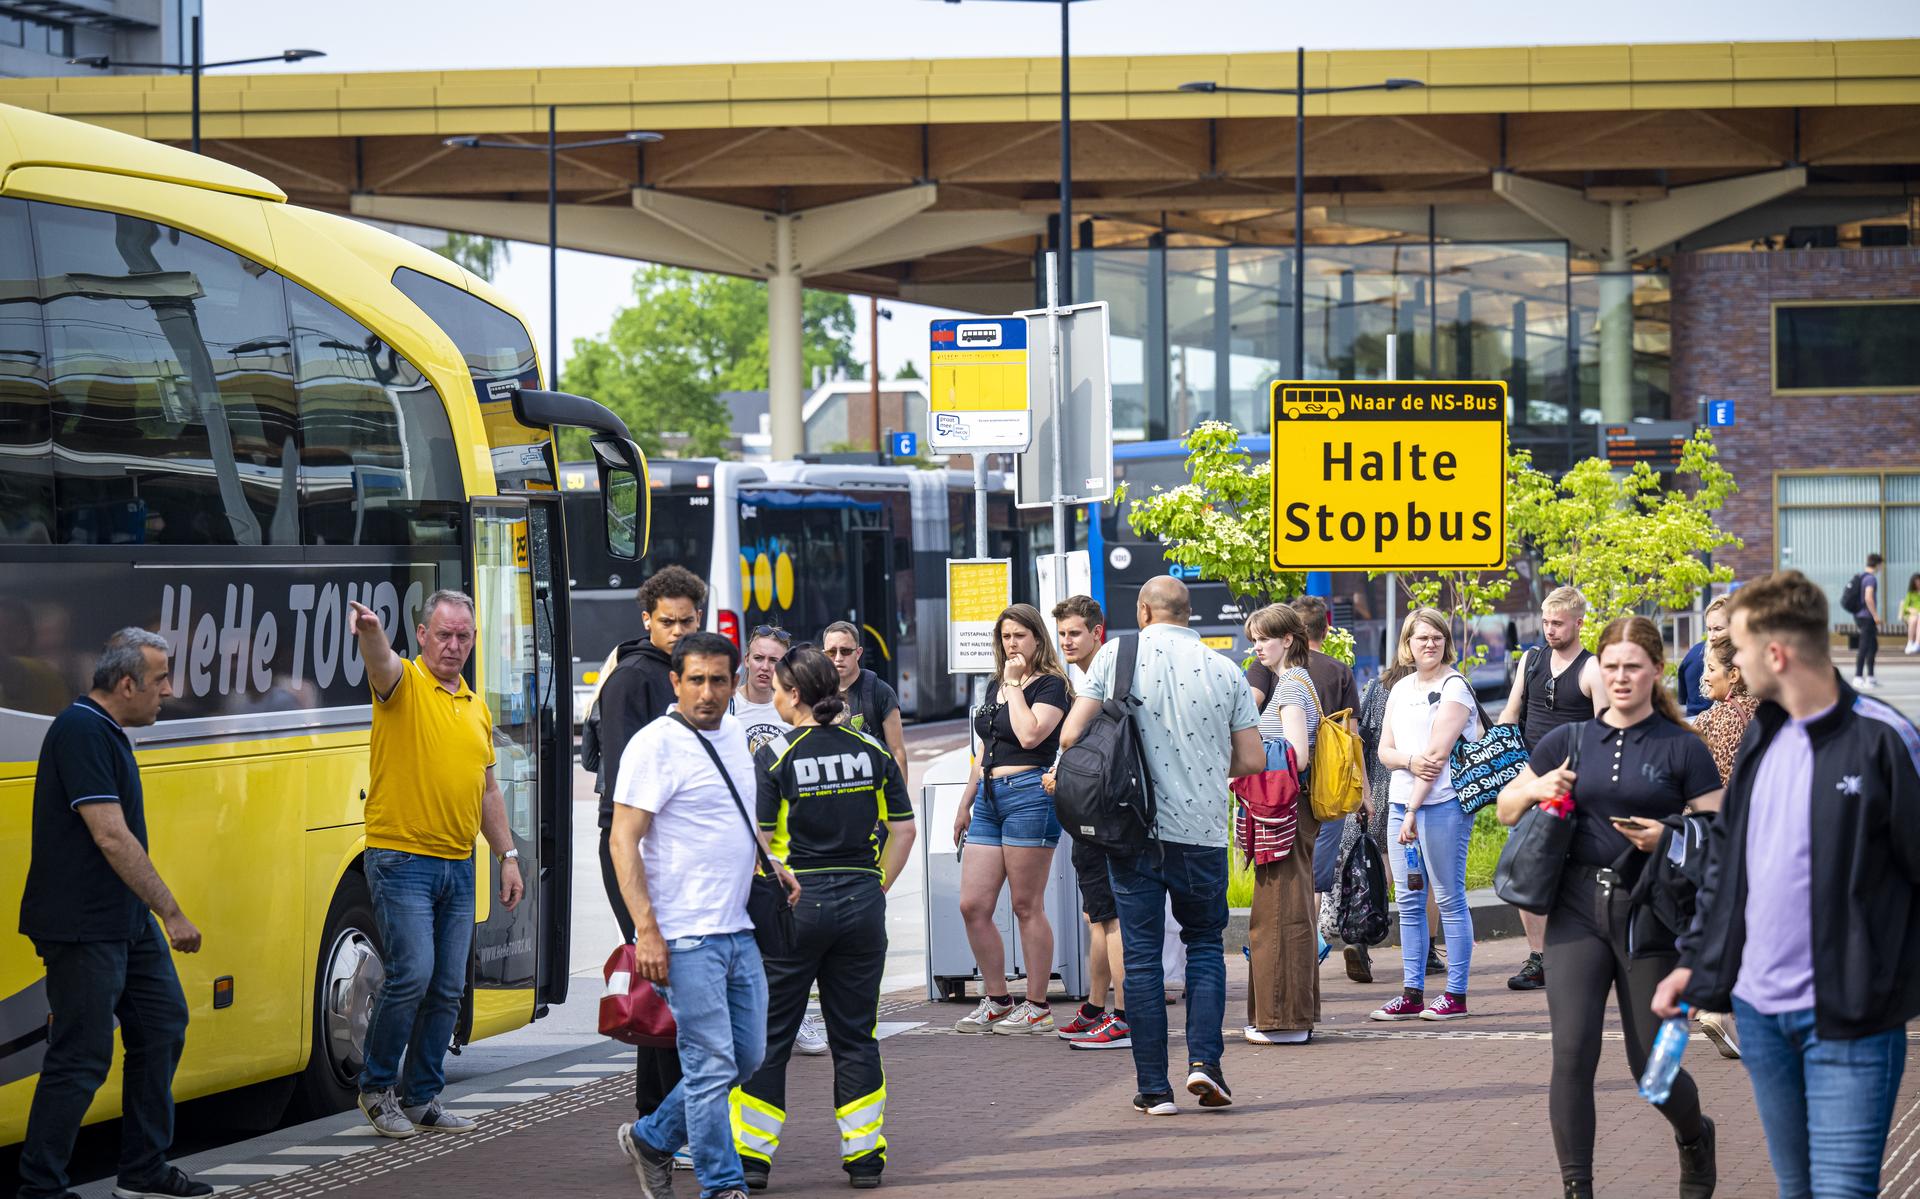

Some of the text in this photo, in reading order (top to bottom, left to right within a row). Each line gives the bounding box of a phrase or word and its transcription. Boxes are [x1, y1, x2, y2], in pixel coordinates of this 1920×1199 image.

[1350, 394, 1497, 411] Naar de NS-Bus
[1716, 408, 1726, 424] E
[900, 439, 911, 455] C
[1323, 441, 1457, 481] Halte
[1284, 501, 1492, 553] Stopbus
[158, 583, 278, 698] HeHe
[793, 752, 873, 785] DTM
[820, 782, 840, 790] TRAFFIC
